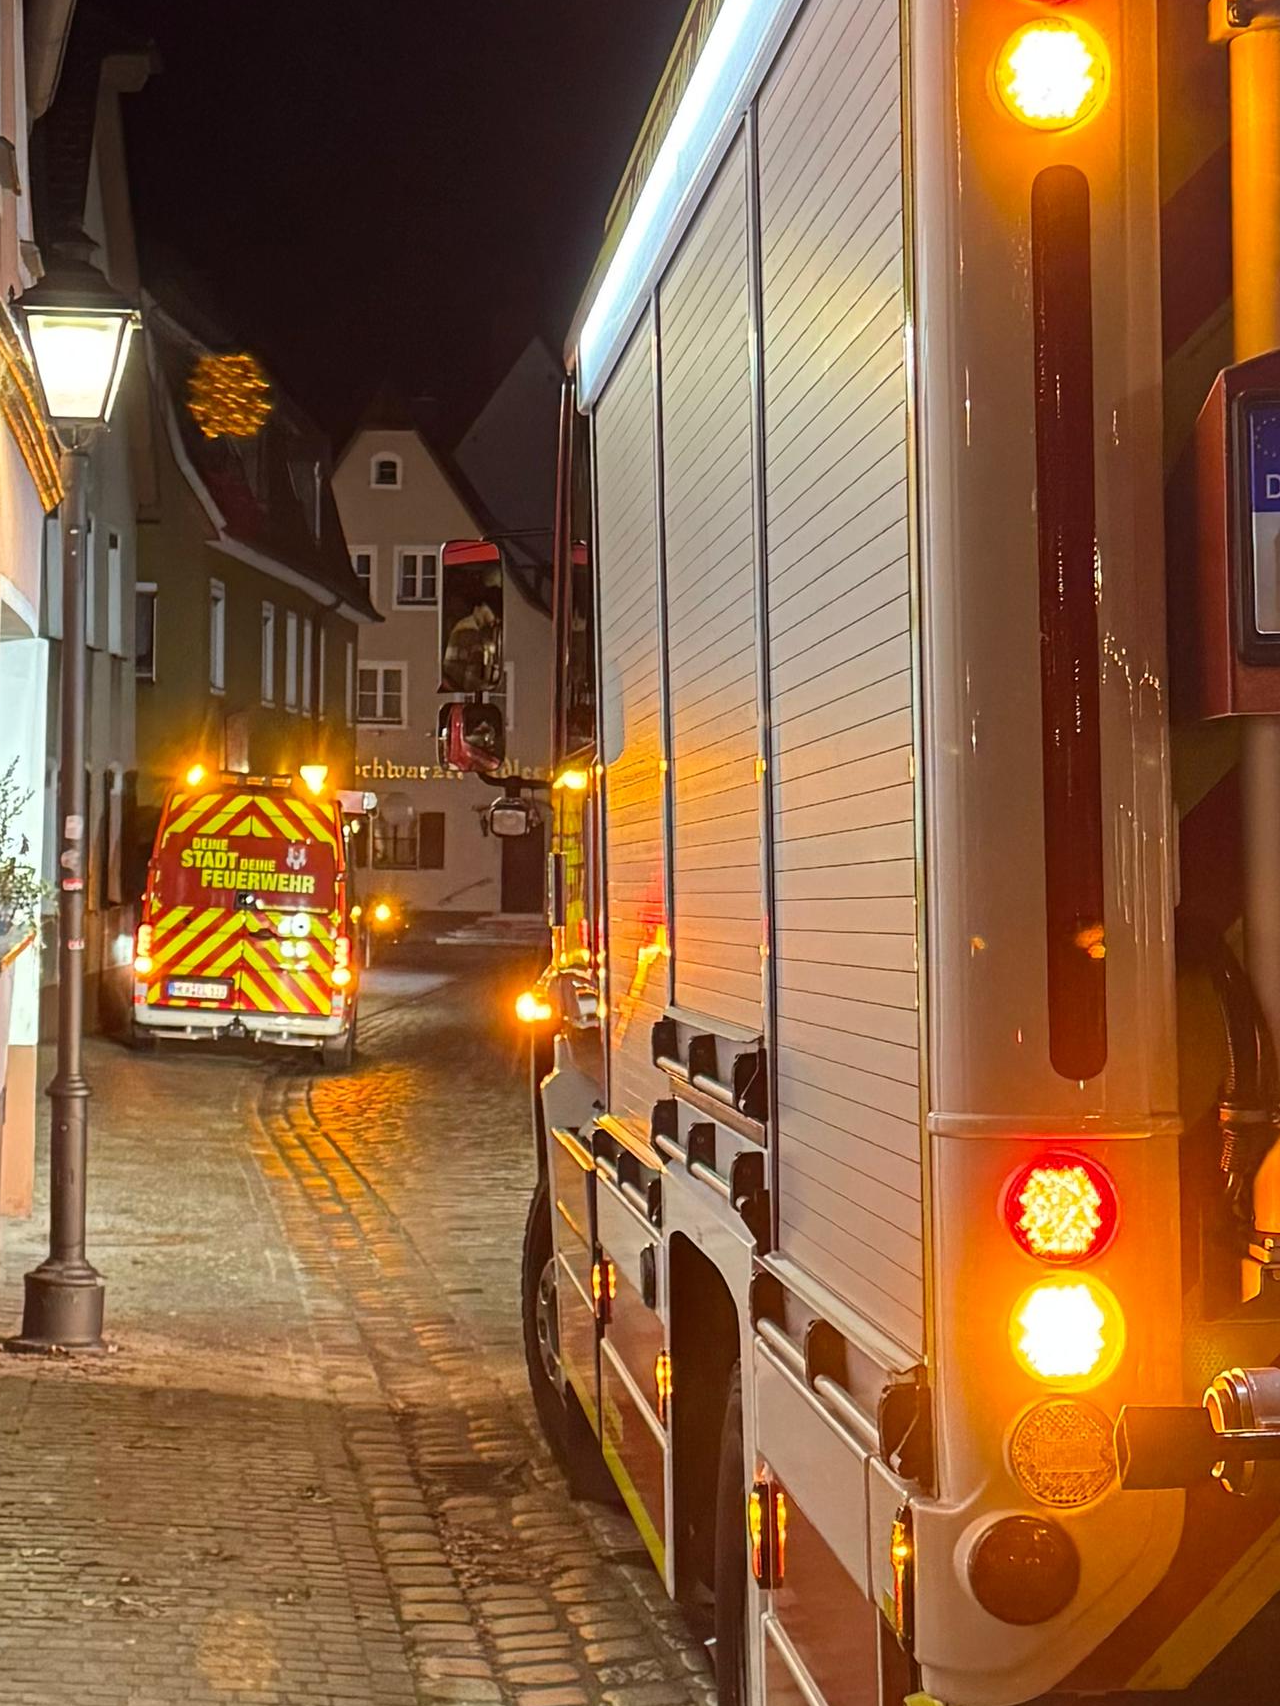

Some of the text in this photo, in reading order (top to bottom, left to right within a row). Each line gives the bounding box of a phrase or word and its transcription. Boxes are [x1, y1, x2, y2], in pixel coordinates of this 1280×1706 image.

[192, 837, 229, 850] DEINE
[181, 849, 276, 872] STADT DEINE
[201, 869, 315, 894] FEUERWEHR
